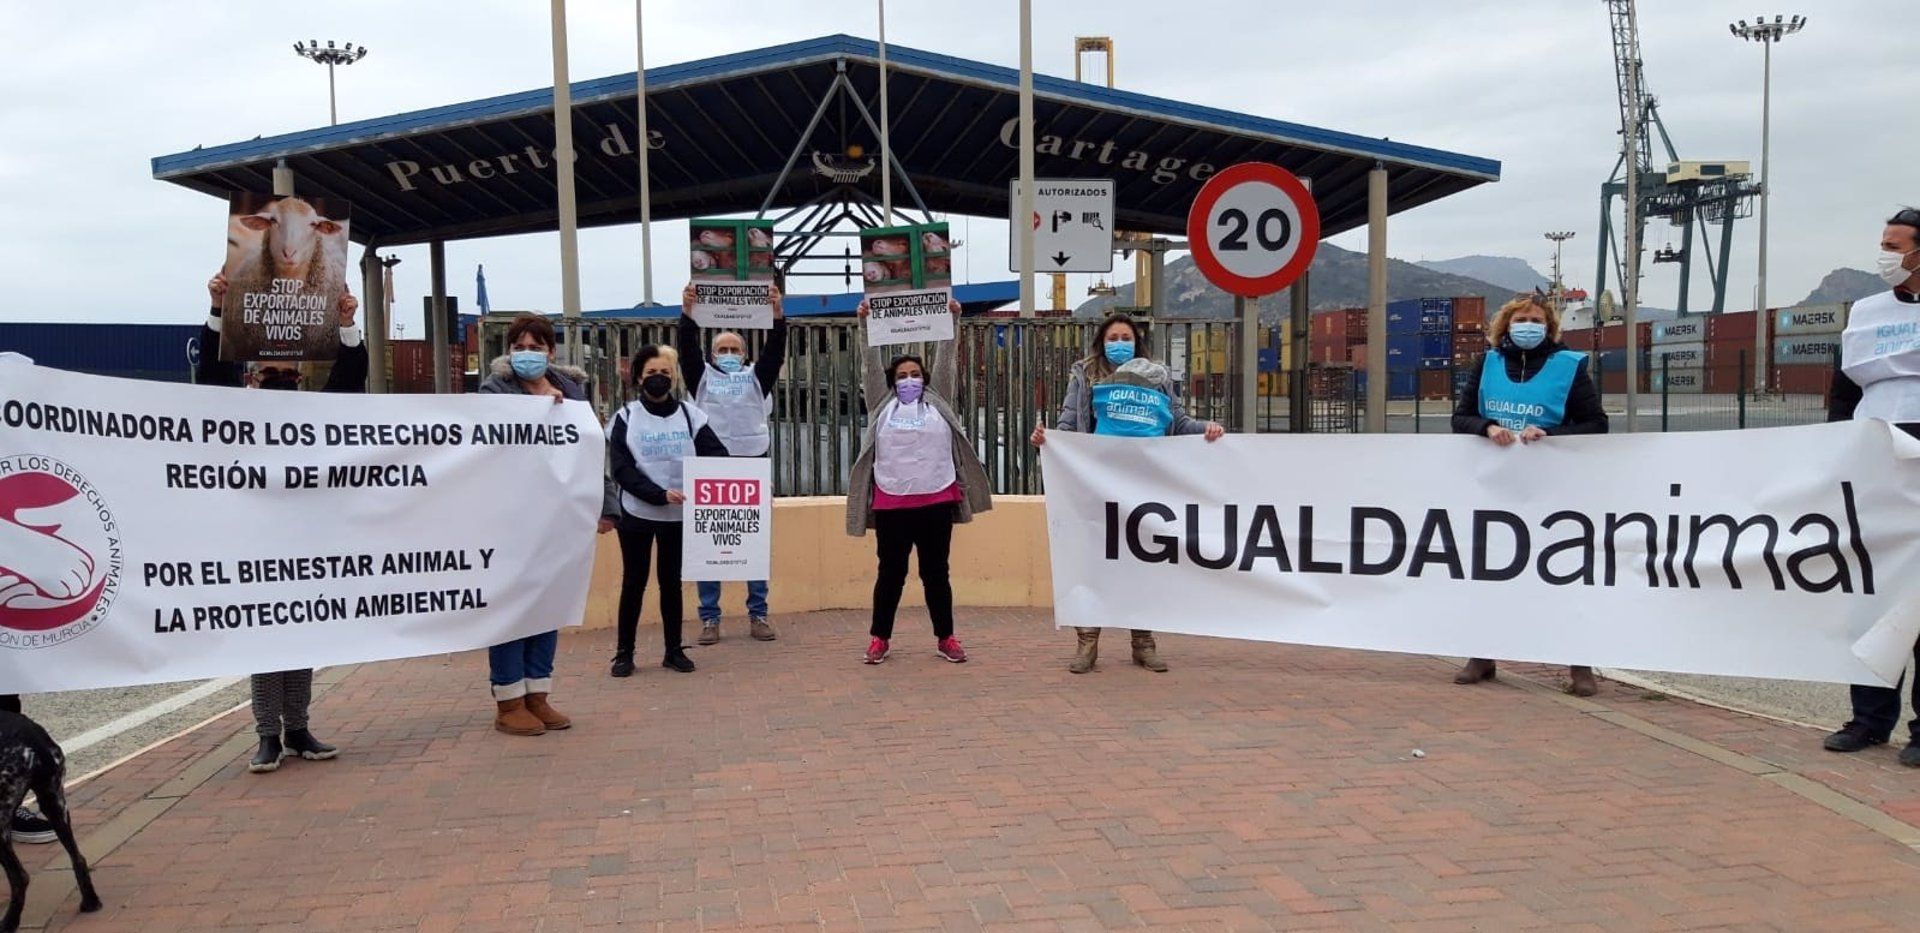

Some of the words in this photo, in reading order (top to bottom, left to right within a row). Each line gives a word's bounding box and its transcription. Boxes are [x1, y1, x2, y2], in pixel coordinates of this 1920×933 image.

[385, 146, 578, 192] Puert
[601, 123, 666, 157] de
[1000, 116, 1215, 185] Cartage
[1038, 188, 1107, 197] AUTORIZADOS
[1217, 208, 1291, 251] 20
[271, 278, 304, 294] STOP
[698, 286, 717, 295] STOP
[243, 292, 327, 311] EXPORTACIÓN
[872, 297, 892, 309] STOP
[243, 309, 261, 324] DE
[262, 310, 325, 326] ANIMALES
[872, 309, 883, 319] DE
[884, 306, 923, 318] ANIMALES
[925, 304, 947, 315] VIVOS
[1792, 311, 1836, 326] MAERSK
[266, 326, 302, 341] VIVOS
[1664, 324, 1697, 337] MAERSK
[1109, 389, 1160, 406] IGUALDAD
[1485, 399, 1544, 418] IGUALDAD
[0, 399, 193, 443] OORDINADORA
[202, 419, 255, 445] POR
[265, 423, 316, 447] LOS
[325, 423, 463, 446] DERECHOS
[471, 423, 580, 446] ANIMALES
[166, 460, 266, 489] REGIÓN
[285, 465, 319, 489] DE
[327, 464, 428, 488] MURCIA
[700, 482, 756, 504] STOP
[18, 456, 50, 472] LOS
[54, 462, 115, 532] DERECHOS
[96, 536, 120, 616] ANIMALES
[695, 521, 708, 534] DE
[709, 521, 760, 534] ANIMALES
[713, 533, 742, 546] VIVOS
[1105, 481, 1875, 595] IGUALDADanimal
[144, 562, 194, 587] POR
[201, 560, 231, 586] EL
[238, 554, 374, 585] BIENESTAR
[381, 549, 472, 576] ANIMAL
[479, 547, 495, 570] Y
[154, 608, 186, 634] LA
[193, 594, 347, 631] PROTECCIÓN
[354, 587, 487, 619] AMBIENTAL
[22, 634, 39, 647] DE
[42, 620, 91, 645] MURCIA
